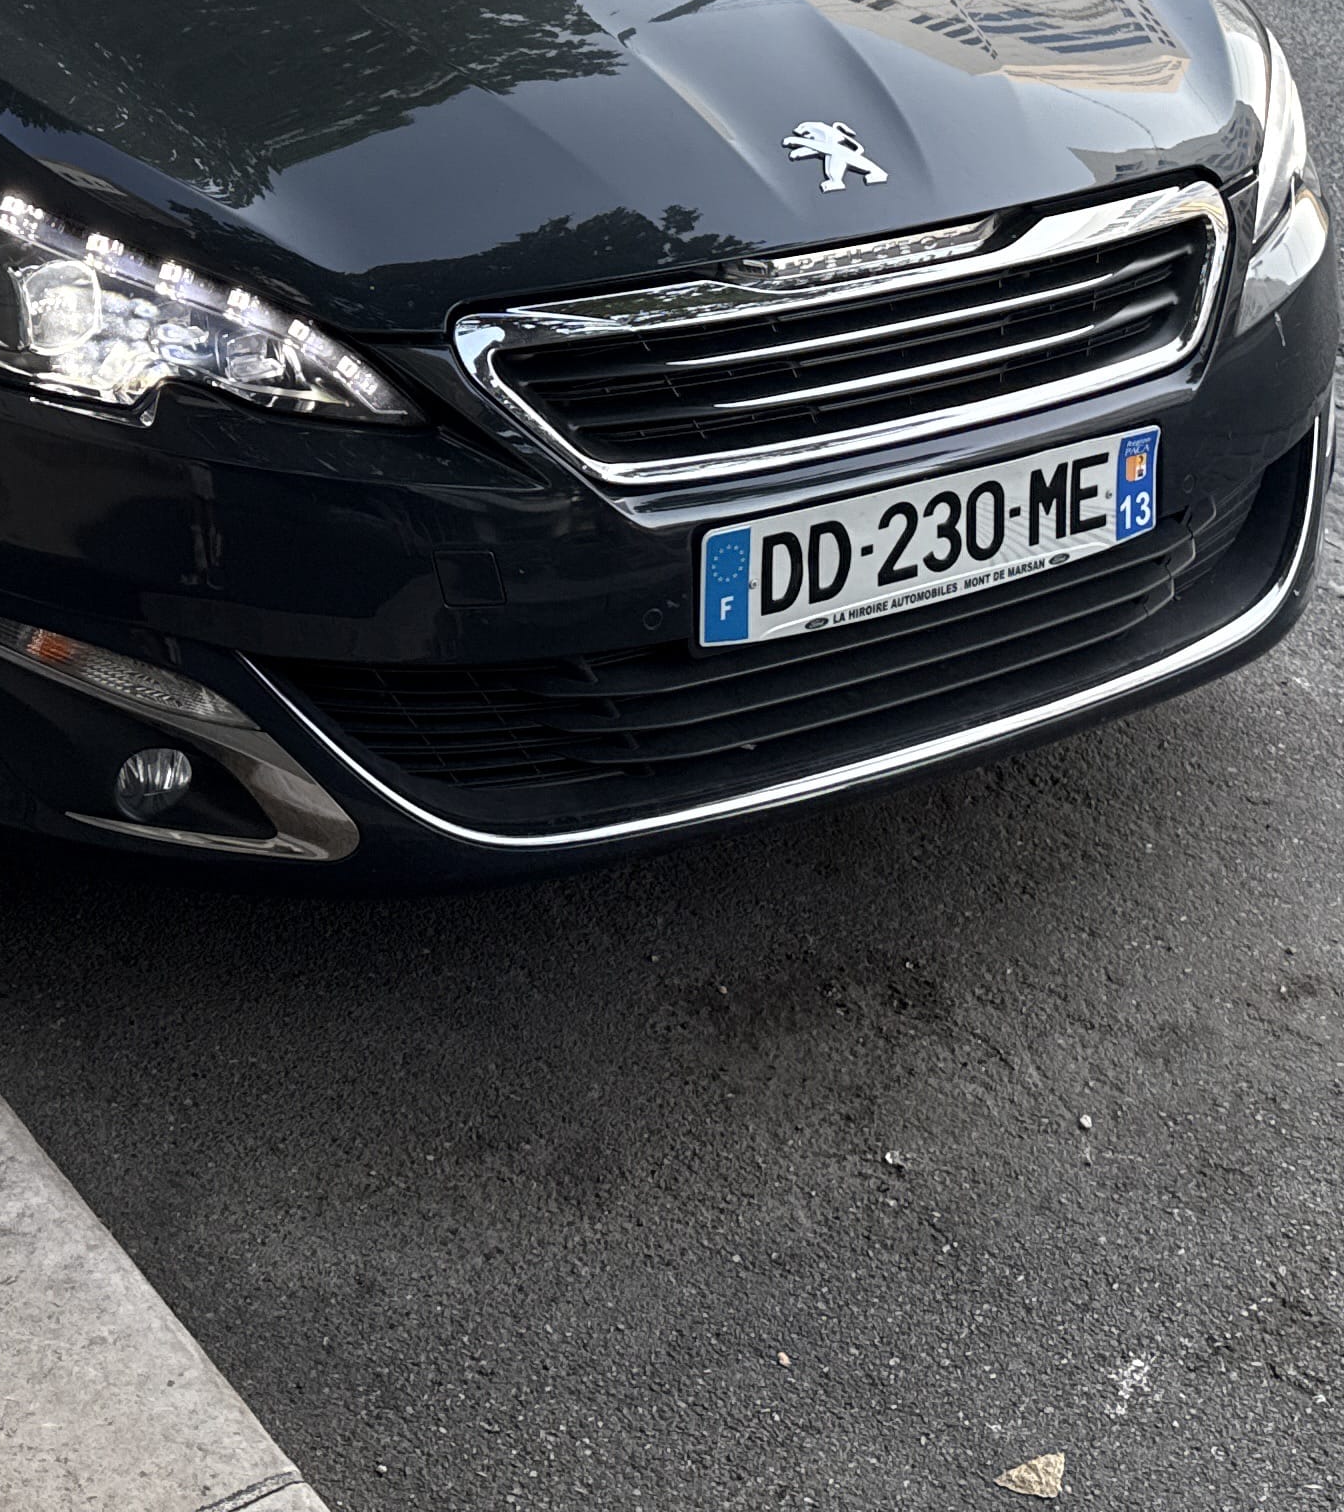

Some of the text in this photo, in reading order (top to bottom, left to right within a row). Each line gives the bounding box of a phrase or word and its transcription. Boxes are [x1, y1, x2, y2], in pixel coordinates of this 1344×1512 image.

[760, 451, 1110, 617] DD-230-ME
[1119, 491, 1151, 529] 13
[719, 595, 734, 621] F
[832, 610, 846, 625] LA
[848, 601, 889, 620] HIROIRE
[890, 582, 958, 609] AUTOMOBILES
[964, 573, 991, 590] MONT
[993, 569, 1006, 582] DE
[1007, 558, 1046, 578] MARSAN
